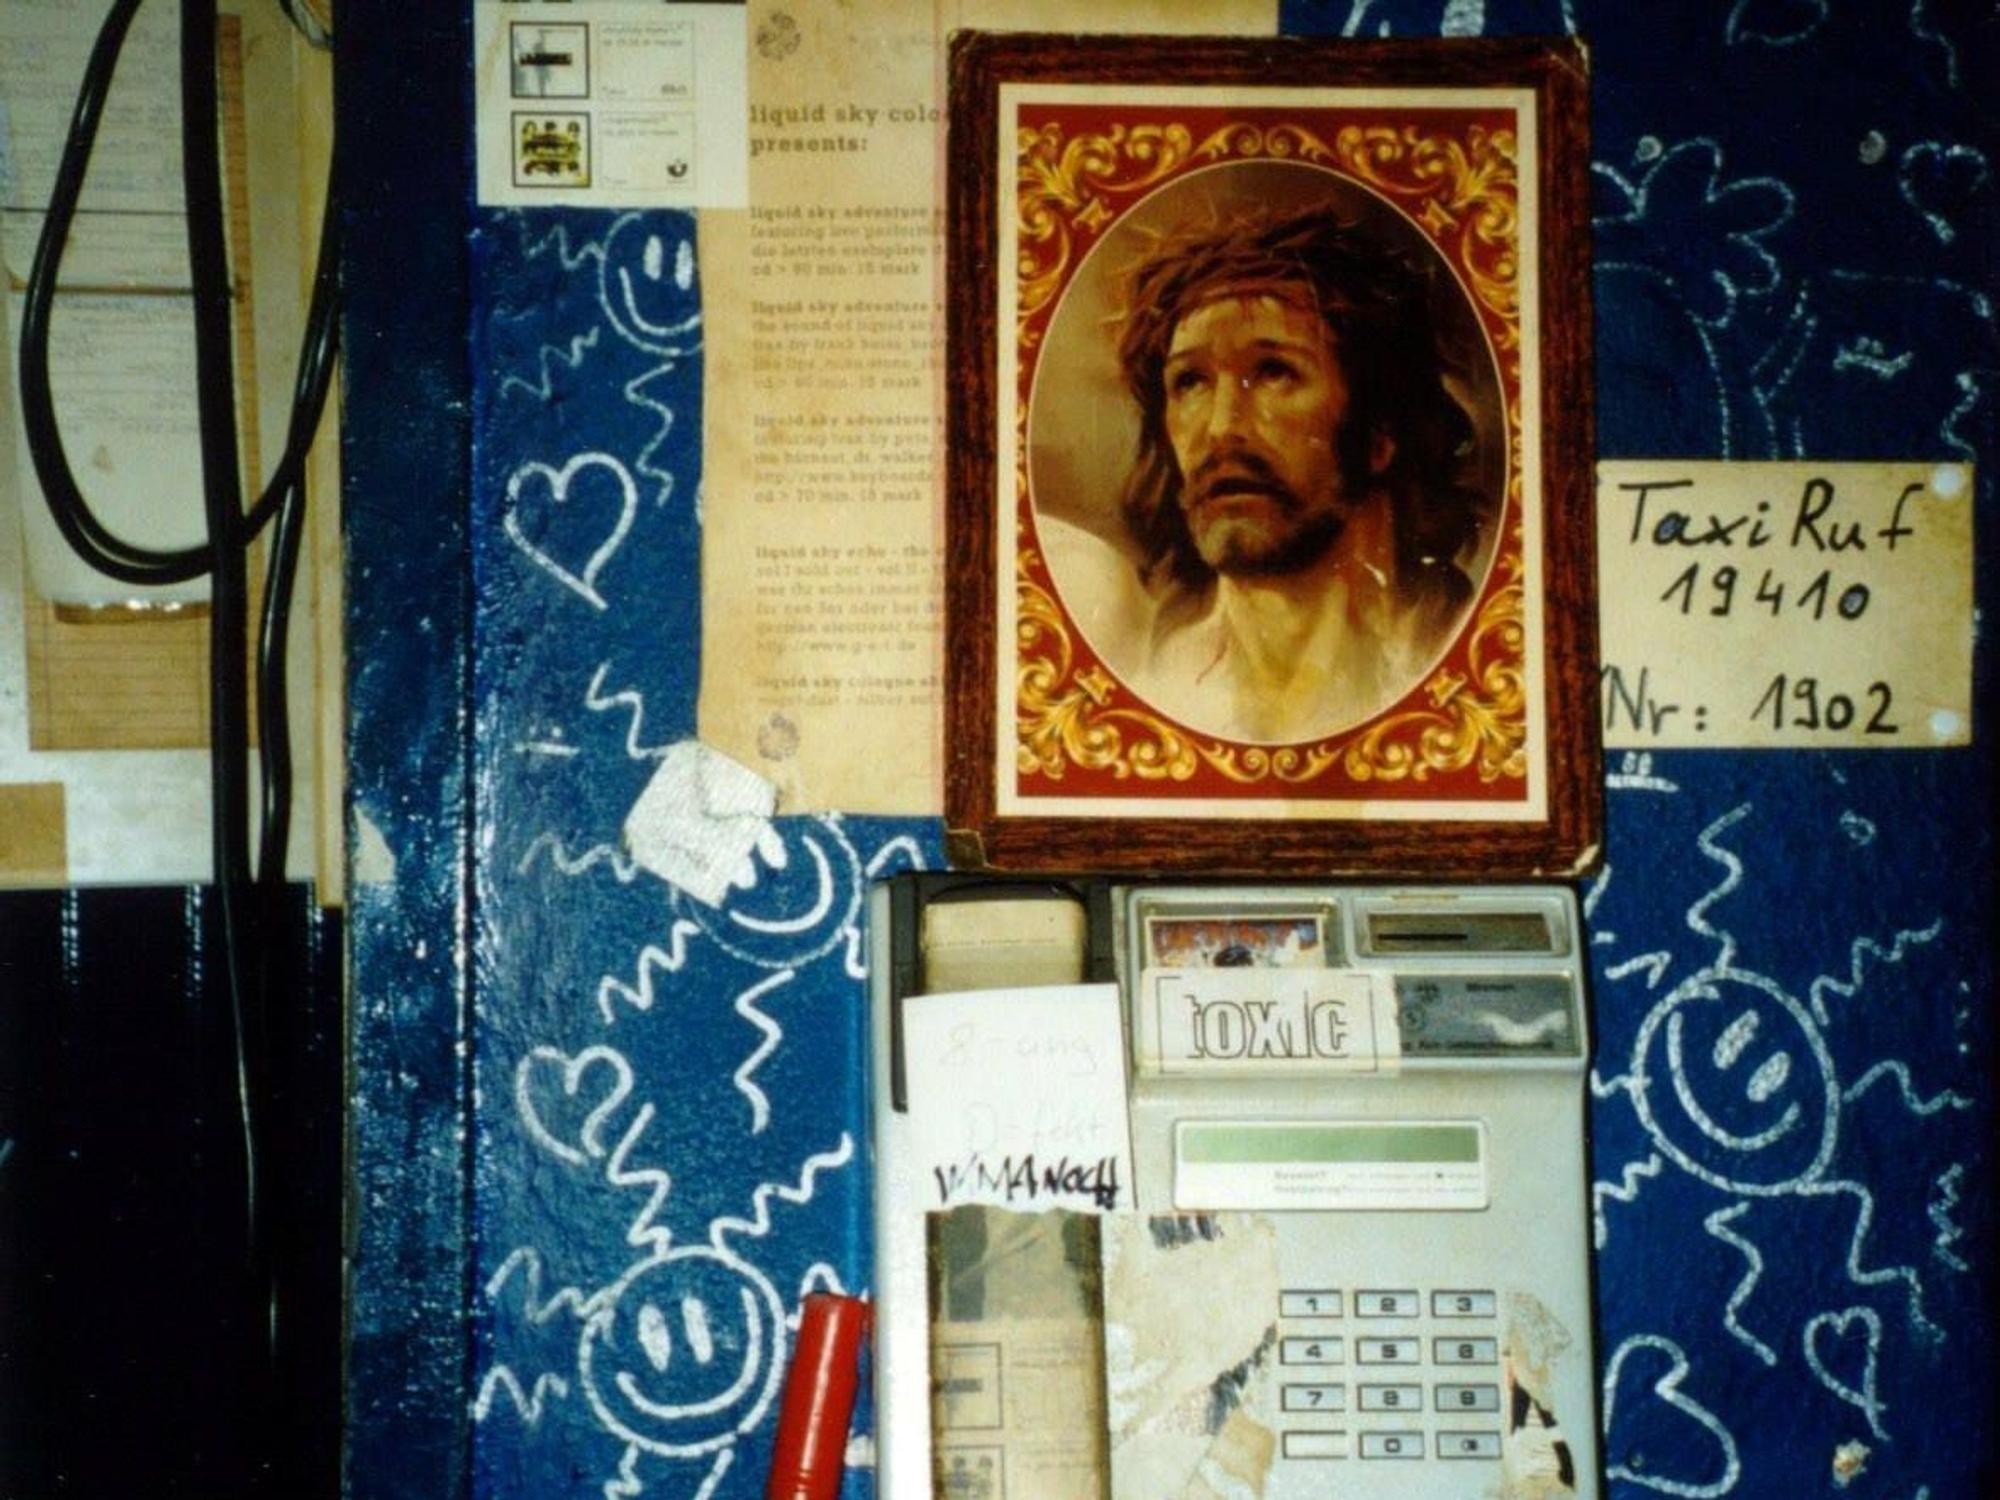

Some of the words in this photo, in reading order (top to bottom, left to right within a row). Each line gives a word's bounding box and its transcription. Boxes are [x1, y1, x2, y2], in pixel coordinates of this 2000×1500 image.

[750, 104, 824, 126] liquid
[835, 104, 878, 127] sky
[888, 103, 943, 122] colo
[750, 136, 868, 156] presents:
[751, 205, 801, 220] liquid
[808, 205, 836, 220] sky
[844, 205, 928, 220] adventure
[752, 301, 802, 316] liquid
[809, 301, 837, 316] sky
[845, 301, 928, 316] adventure
[754, 414, 804, 429] liquid
[810, 414, 838, 429] sky
[846, 414, 929, 429] adventure
[1618, 479, 1771, 547] Taxi
[1790, 478, 1925, 552] Ruf
[755, 546, 806, 560] liquid
[811, 546, 841, 560] sky
[1661, 562, 1871, 620] 19410
[1600, 663, 1707, 736] Nr:
[1750, 673, 1899, 735] 1902
[1305, 1297, 1318, 1312] 1
[1380, 1297, 1397, 1312] 2
[1456, 1297, 1473, 1312] 3
[1305, 1344, 1322, 1359] 4
[1380, 1344, 1398, 1359] 5
[1307, 1390, 1323, 1406] 7
[1384, 1438, 1402, 1453] 0
